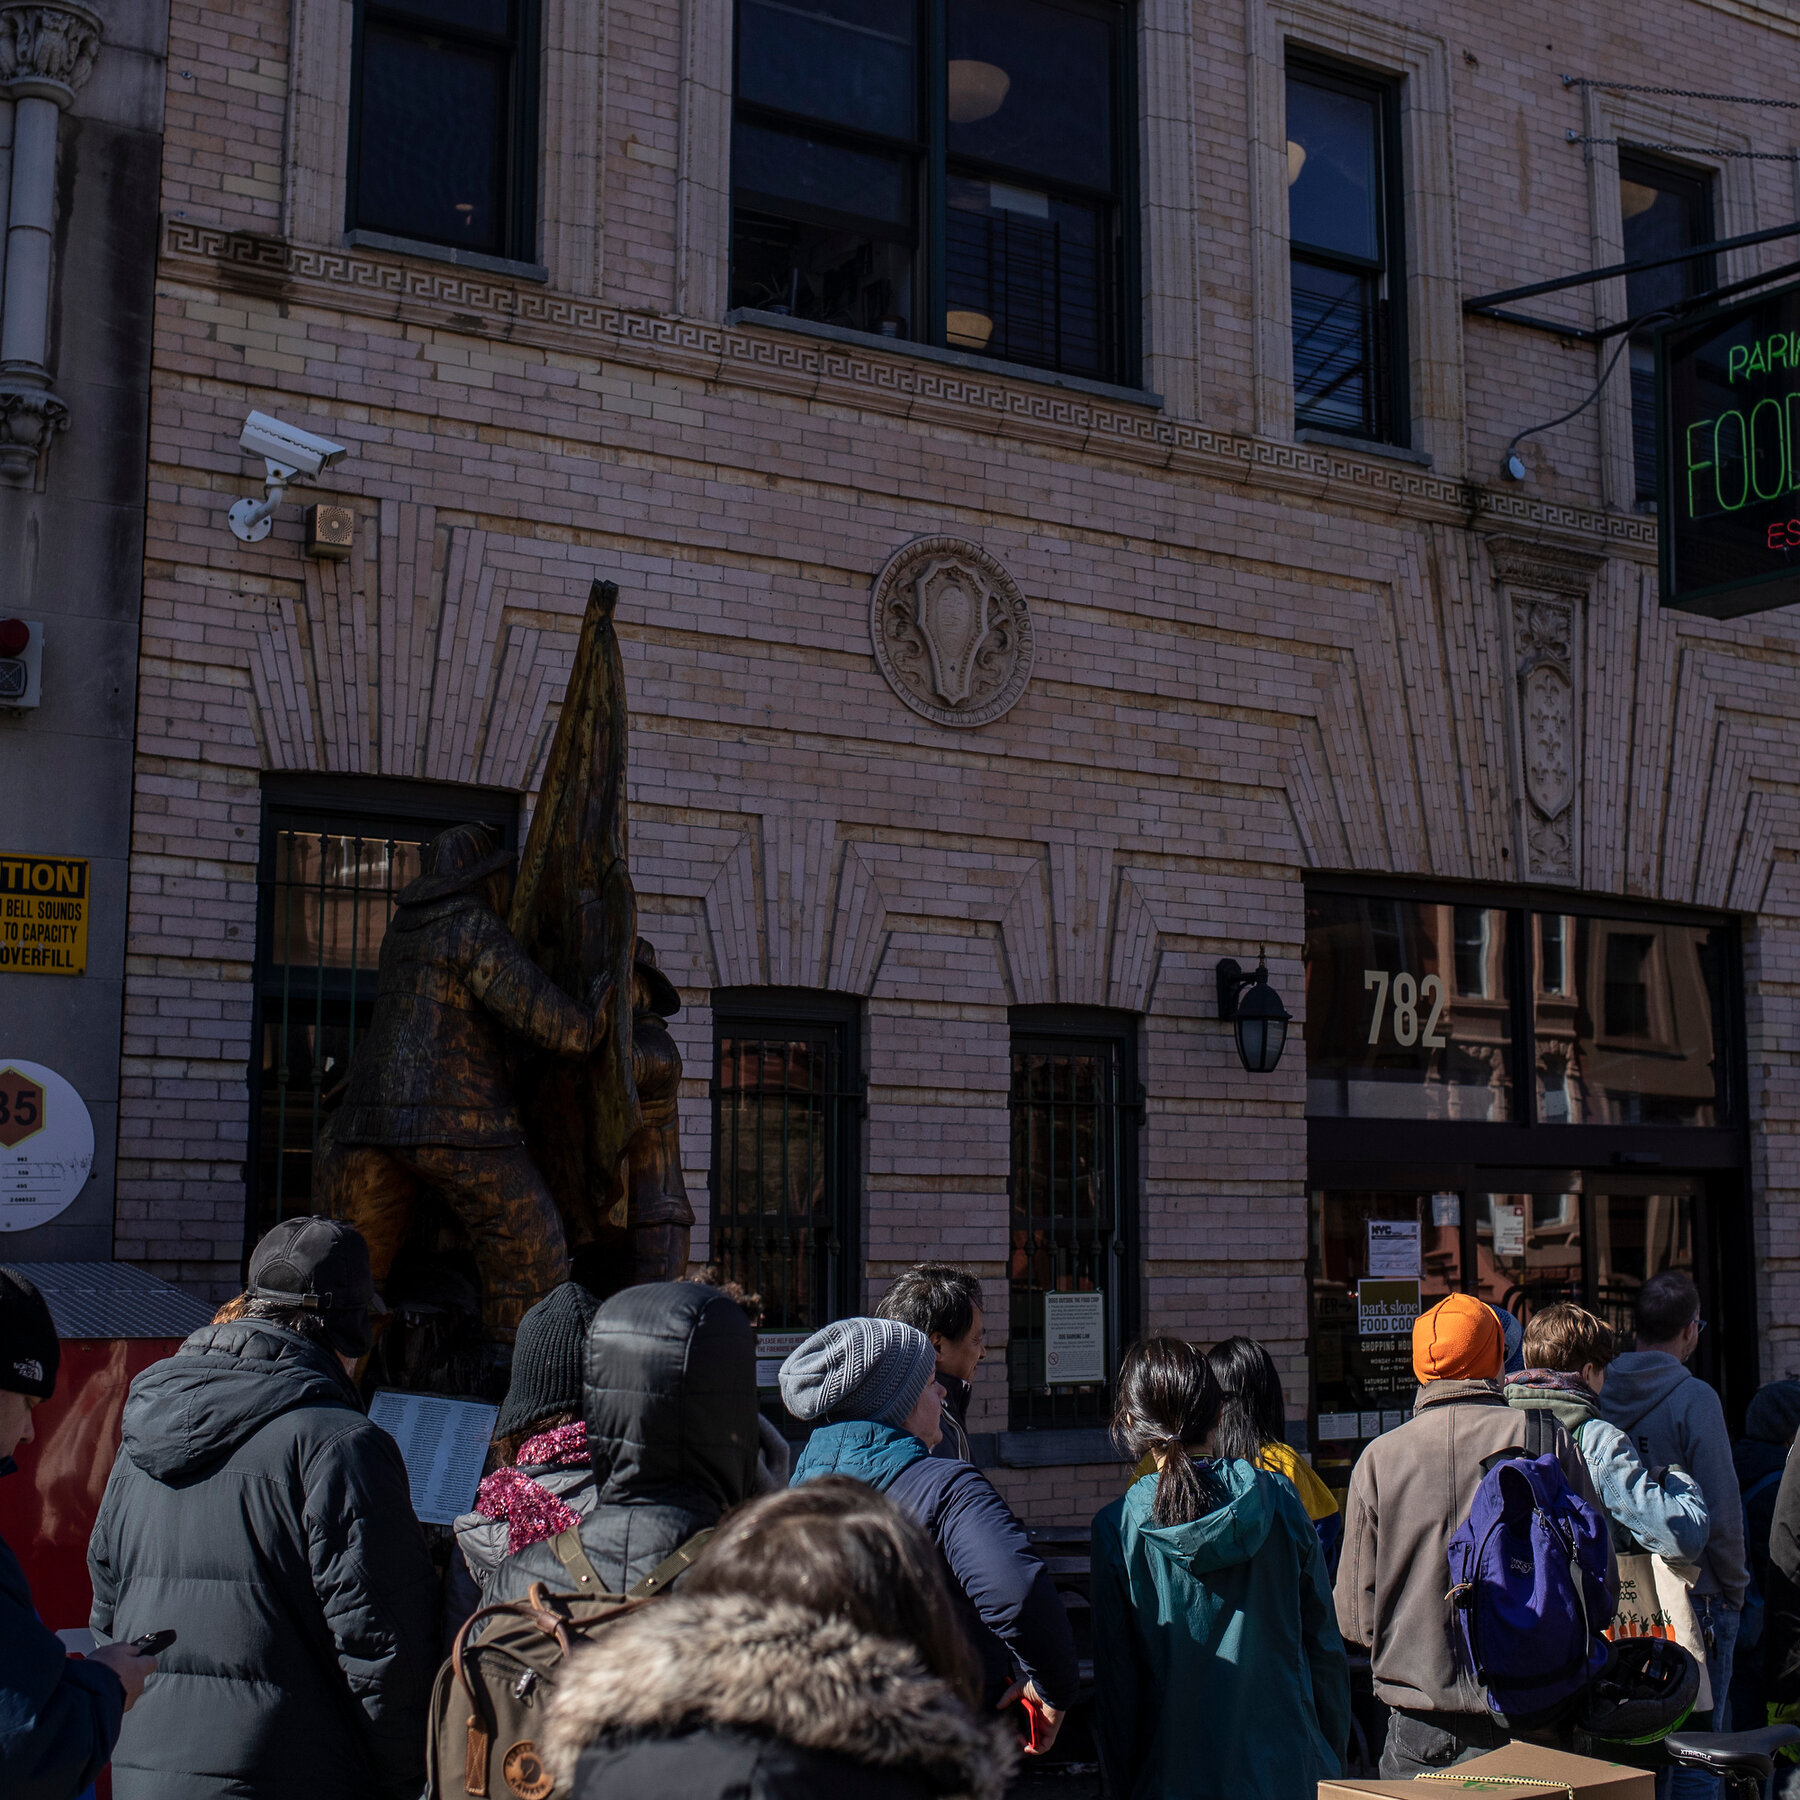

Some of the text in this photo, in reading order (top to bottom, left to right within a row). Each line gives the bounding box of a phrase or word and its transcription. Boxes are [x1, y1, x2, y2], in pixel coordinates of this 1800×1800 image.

[0, 861, 79, 893] TION
[6, 899, 33, 918] BELL
[38, 901, 82, 921] SOUNDS
[4, 921, 77, 943] TO CAPACITY
[0, 946, 74, 968] OVERFILL
[1364, 969, 1446, 1048] 782
[1371, 1225, 1391, 1234] NYC
[1361, 1299, 1418, 1317] park slope
[1360, 1318, 1388, 1332] FOOD
[1391, 1317, 1416, 1331] COO
[1361, 1340, 1395, 1352] SHOPPING
